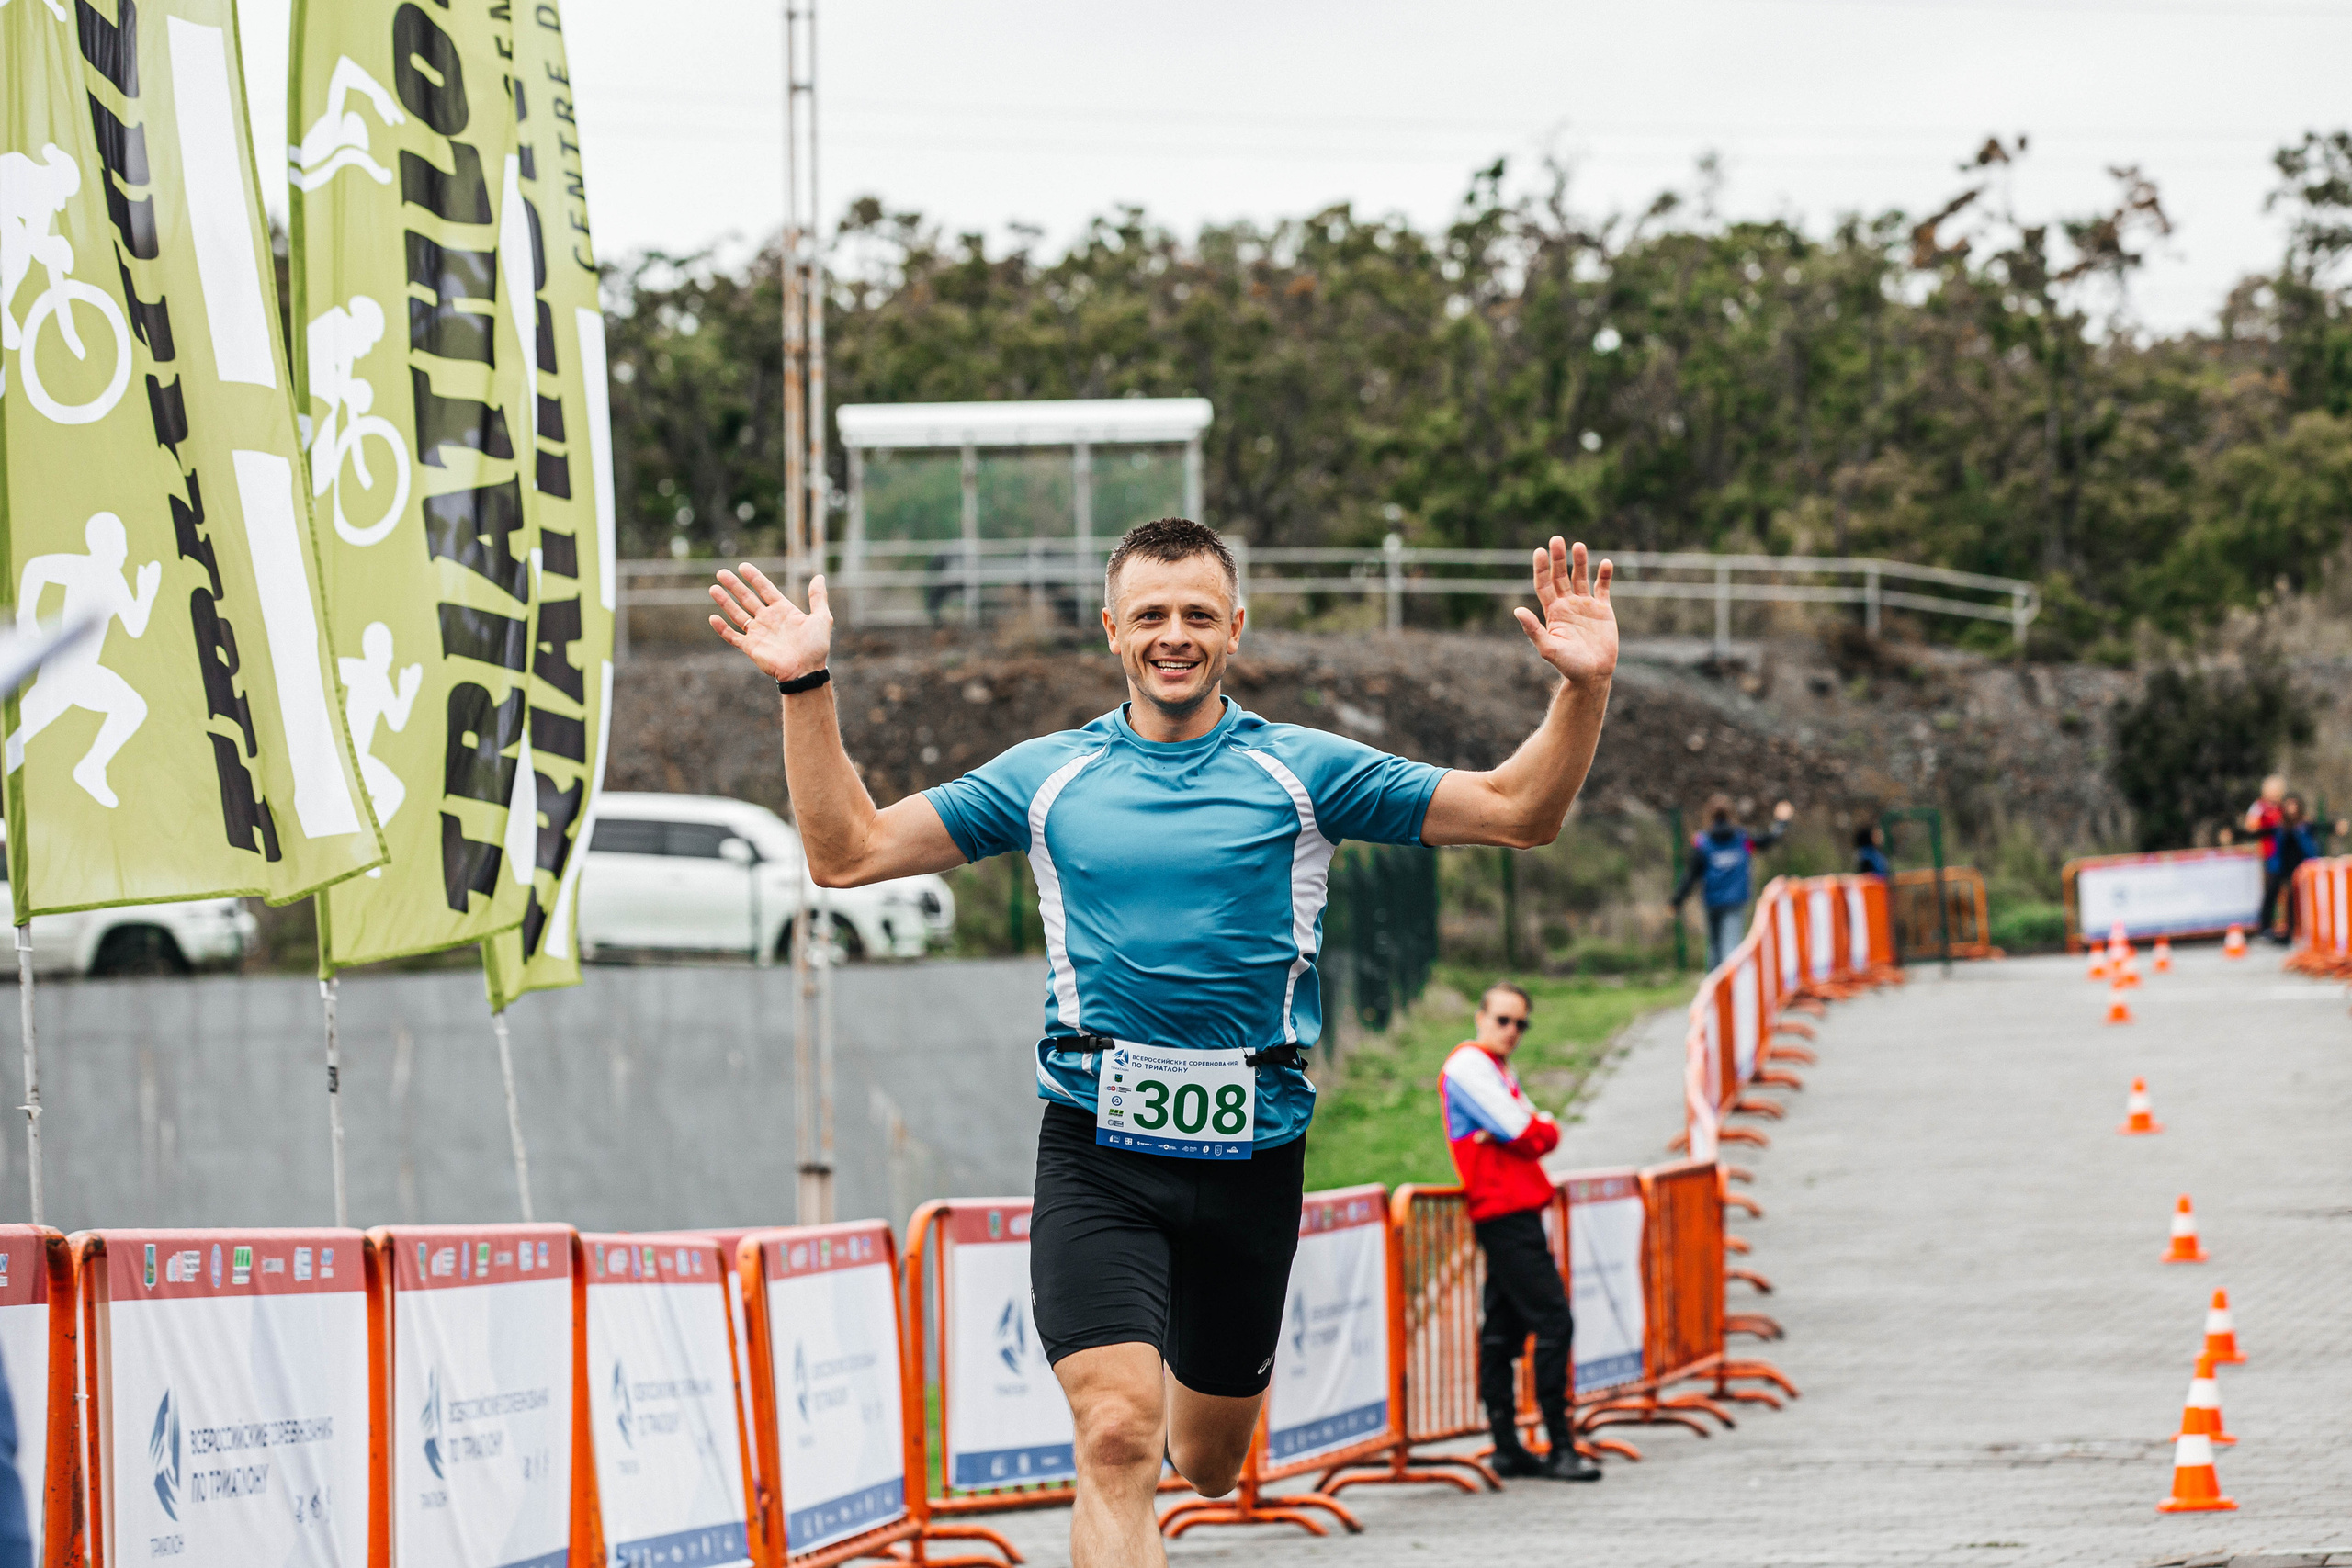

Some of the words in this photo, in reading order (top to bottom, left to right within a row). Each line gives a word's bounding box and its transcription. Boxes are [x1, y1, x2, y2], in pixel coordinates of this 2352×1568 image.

[392, 0, 530, 914] TRIATHLO
[1132, 1055, 1186, 1066] ВСЕРОССИЙСКИЕ
[1145, 1064, 1188, 1073] ТРИАТЛОНУ
[1133, 1079, 1247, 1135] 308
